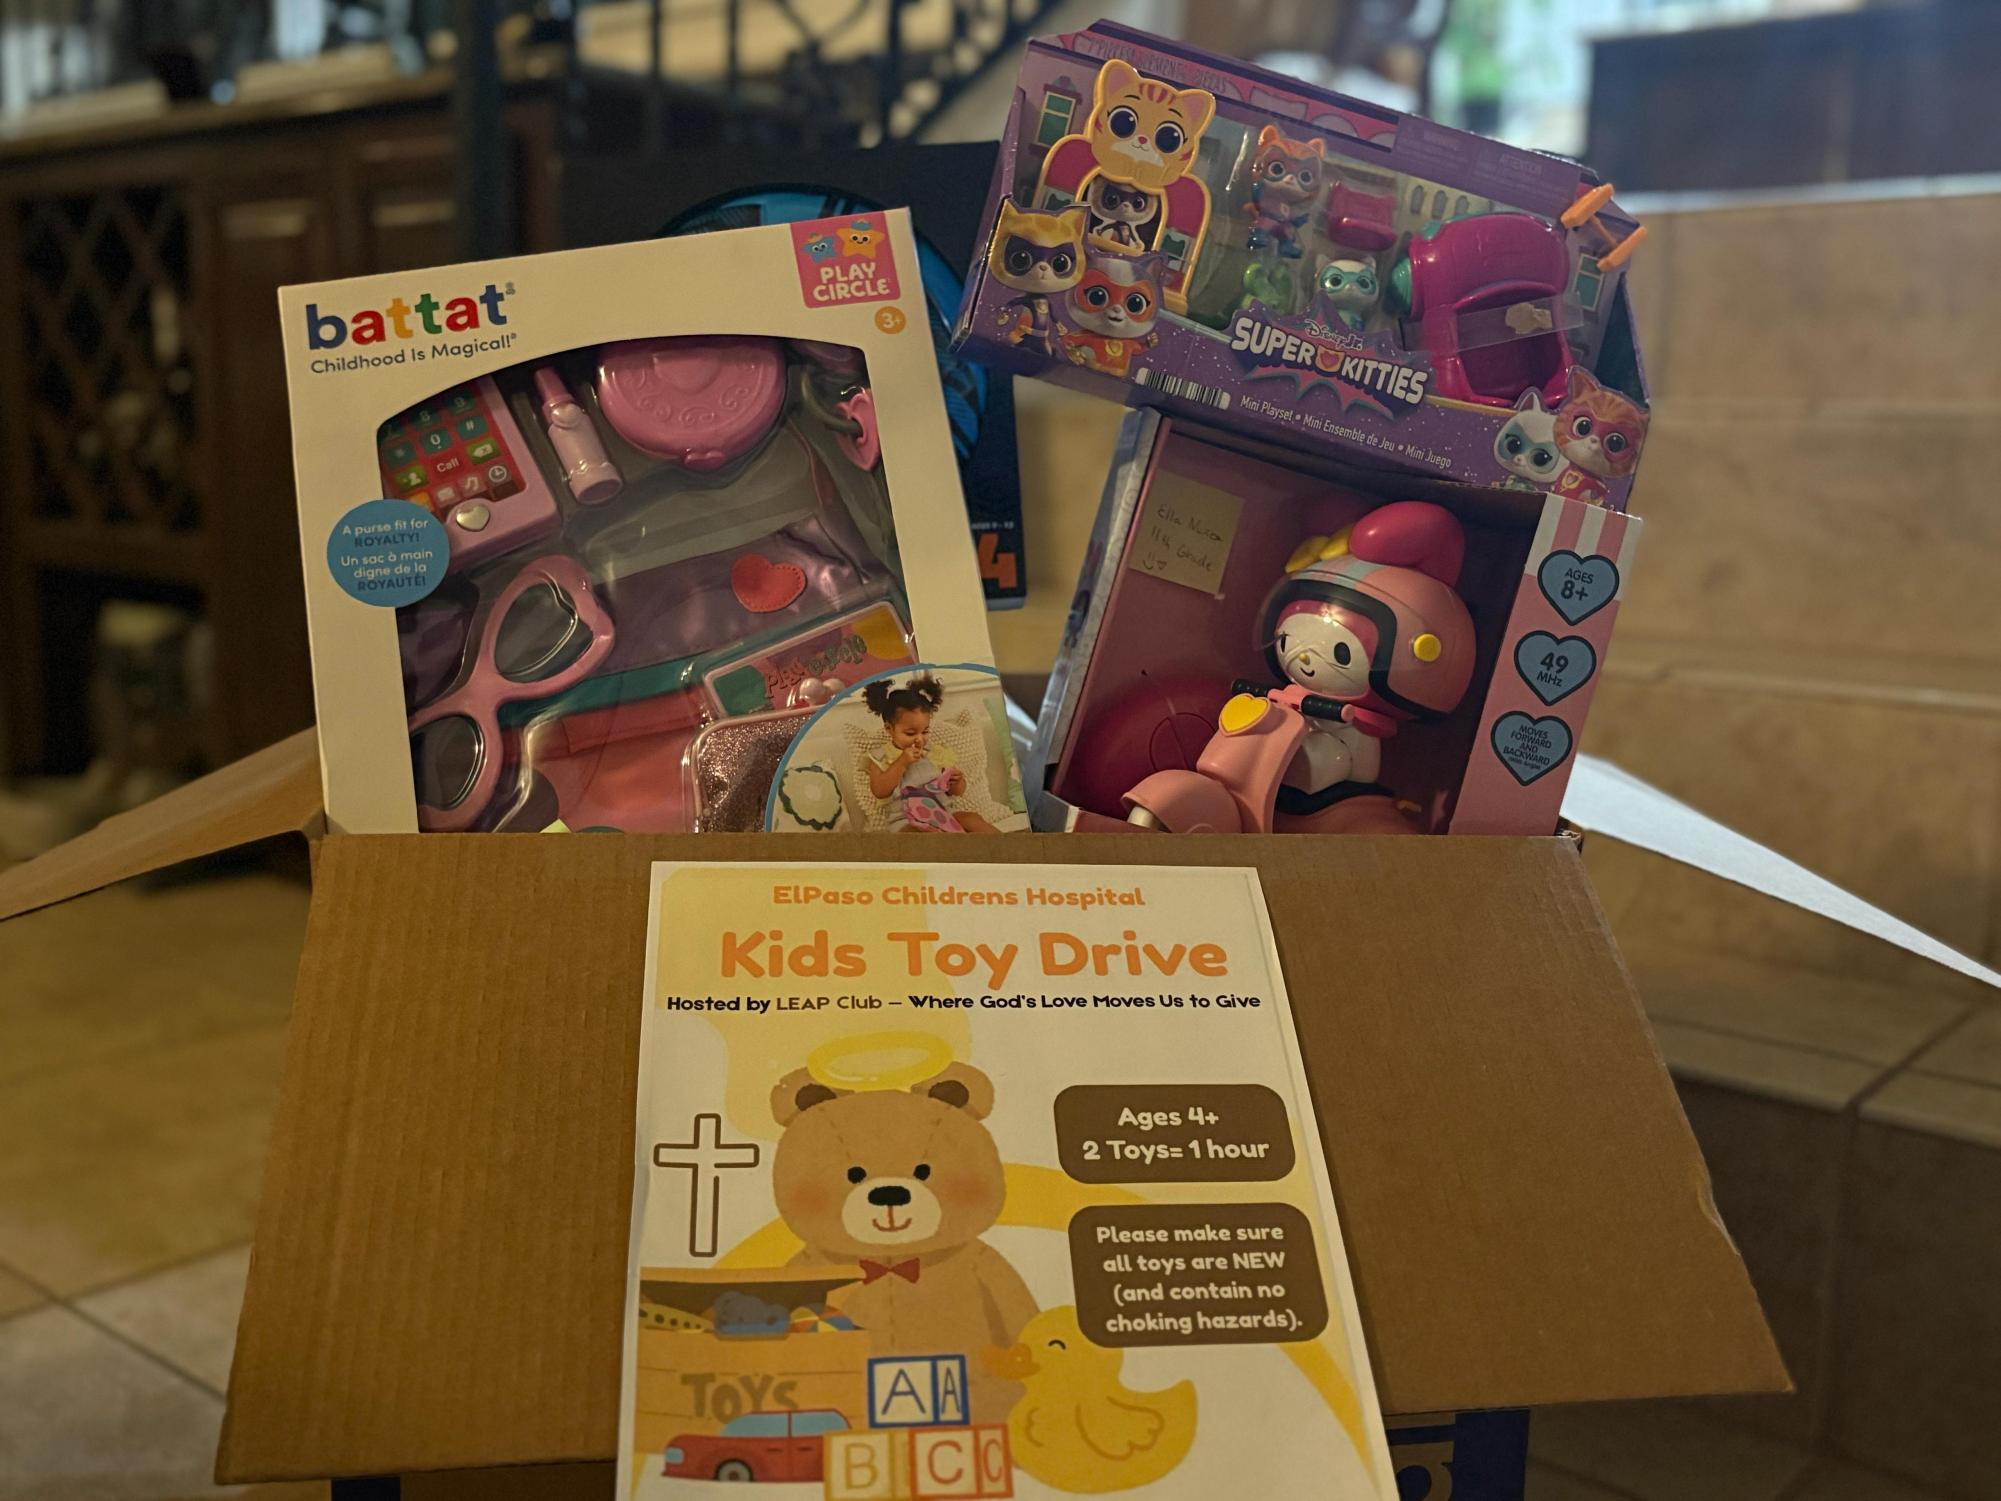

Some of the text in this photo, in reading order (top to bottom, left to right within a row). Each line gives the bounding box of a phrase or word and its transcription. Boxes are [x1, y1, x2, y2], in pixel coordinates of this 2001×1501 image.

[820, 262, 876, 284] PLAY
[812, 279, 890, 301] CIRCLE
[882, 312, 902, 329] 3+
[310, 349, 406, 374] Childhood
[412, 348, 425, 361] Is
[1231, 316, 1428, 405] SUPER KITTIES
[1240, 395, 1452, 470] Mini Playset Mini Ensemble de Jeu Mini Juego
[436, 457, 460, 473] Call
[342, 518, 429, 537] A purse fit for
[354, 532, 420, 548] ROYALTY!
[340, 549, 433, 566] Un sac à main
[979, 533, 1017, 589] 4
[353, 562, 427, 580] digne de la
[1564, 568, 1594, 584] AGES
[357, 574, 427, 592] ROYAUTÉ!
[1560, 580, 1588, 600] 8+
[1540, 652, 1569, 674] 49
[1536, 671, 1563, 687] MHz
[1510, 730, 1552, 749] FORWARD
[1519, 725, 1548, 739] MOVES
[1503, 746, 1550, 766] BACKWARD
[1519, 742, 1538, 753] AND
[773, 885, 1145, 911] ElPaso Childrens Hospital
[721, 929, 1228, 991] Kids Toy Drive
[667, 996, 741, 1011] Hosted
[747, 996, 771, 1014] by
[776, 997, 830, 1011] LEAP
[837, 995, 883, 1010] Club
[908, 995, 974, 1009] Where
[980, 994, 1037, 1009] God's
[1041, 995, 1088, 1009] Love
[1093, 994, 1155, 1009] Moves
[1159, 995, 1184, 1008] Us
[1190, 995, 1210, 1008] to
[1215, 994, 1261, 1008] Give
[1118, 1106, 1219, 1131] Ages 4+
[1082, 1138, 1270, 1165] 2 Toys= 1 hour
[1096, 1224, 1284, 1244] Please make sure
[1103, 1251, 1285, 1276] all toys are NEW
[1113, 1281, 1285, 1307] (and contain no
[1105, 1308, 1303, 1334] choking hazards).
[680, 1373, 799, 1425] TOYS
[881, 1366, 961, 1415] A A
[844, 1442, 879, 1490] B
[927, 1440, 964, 1484] C
